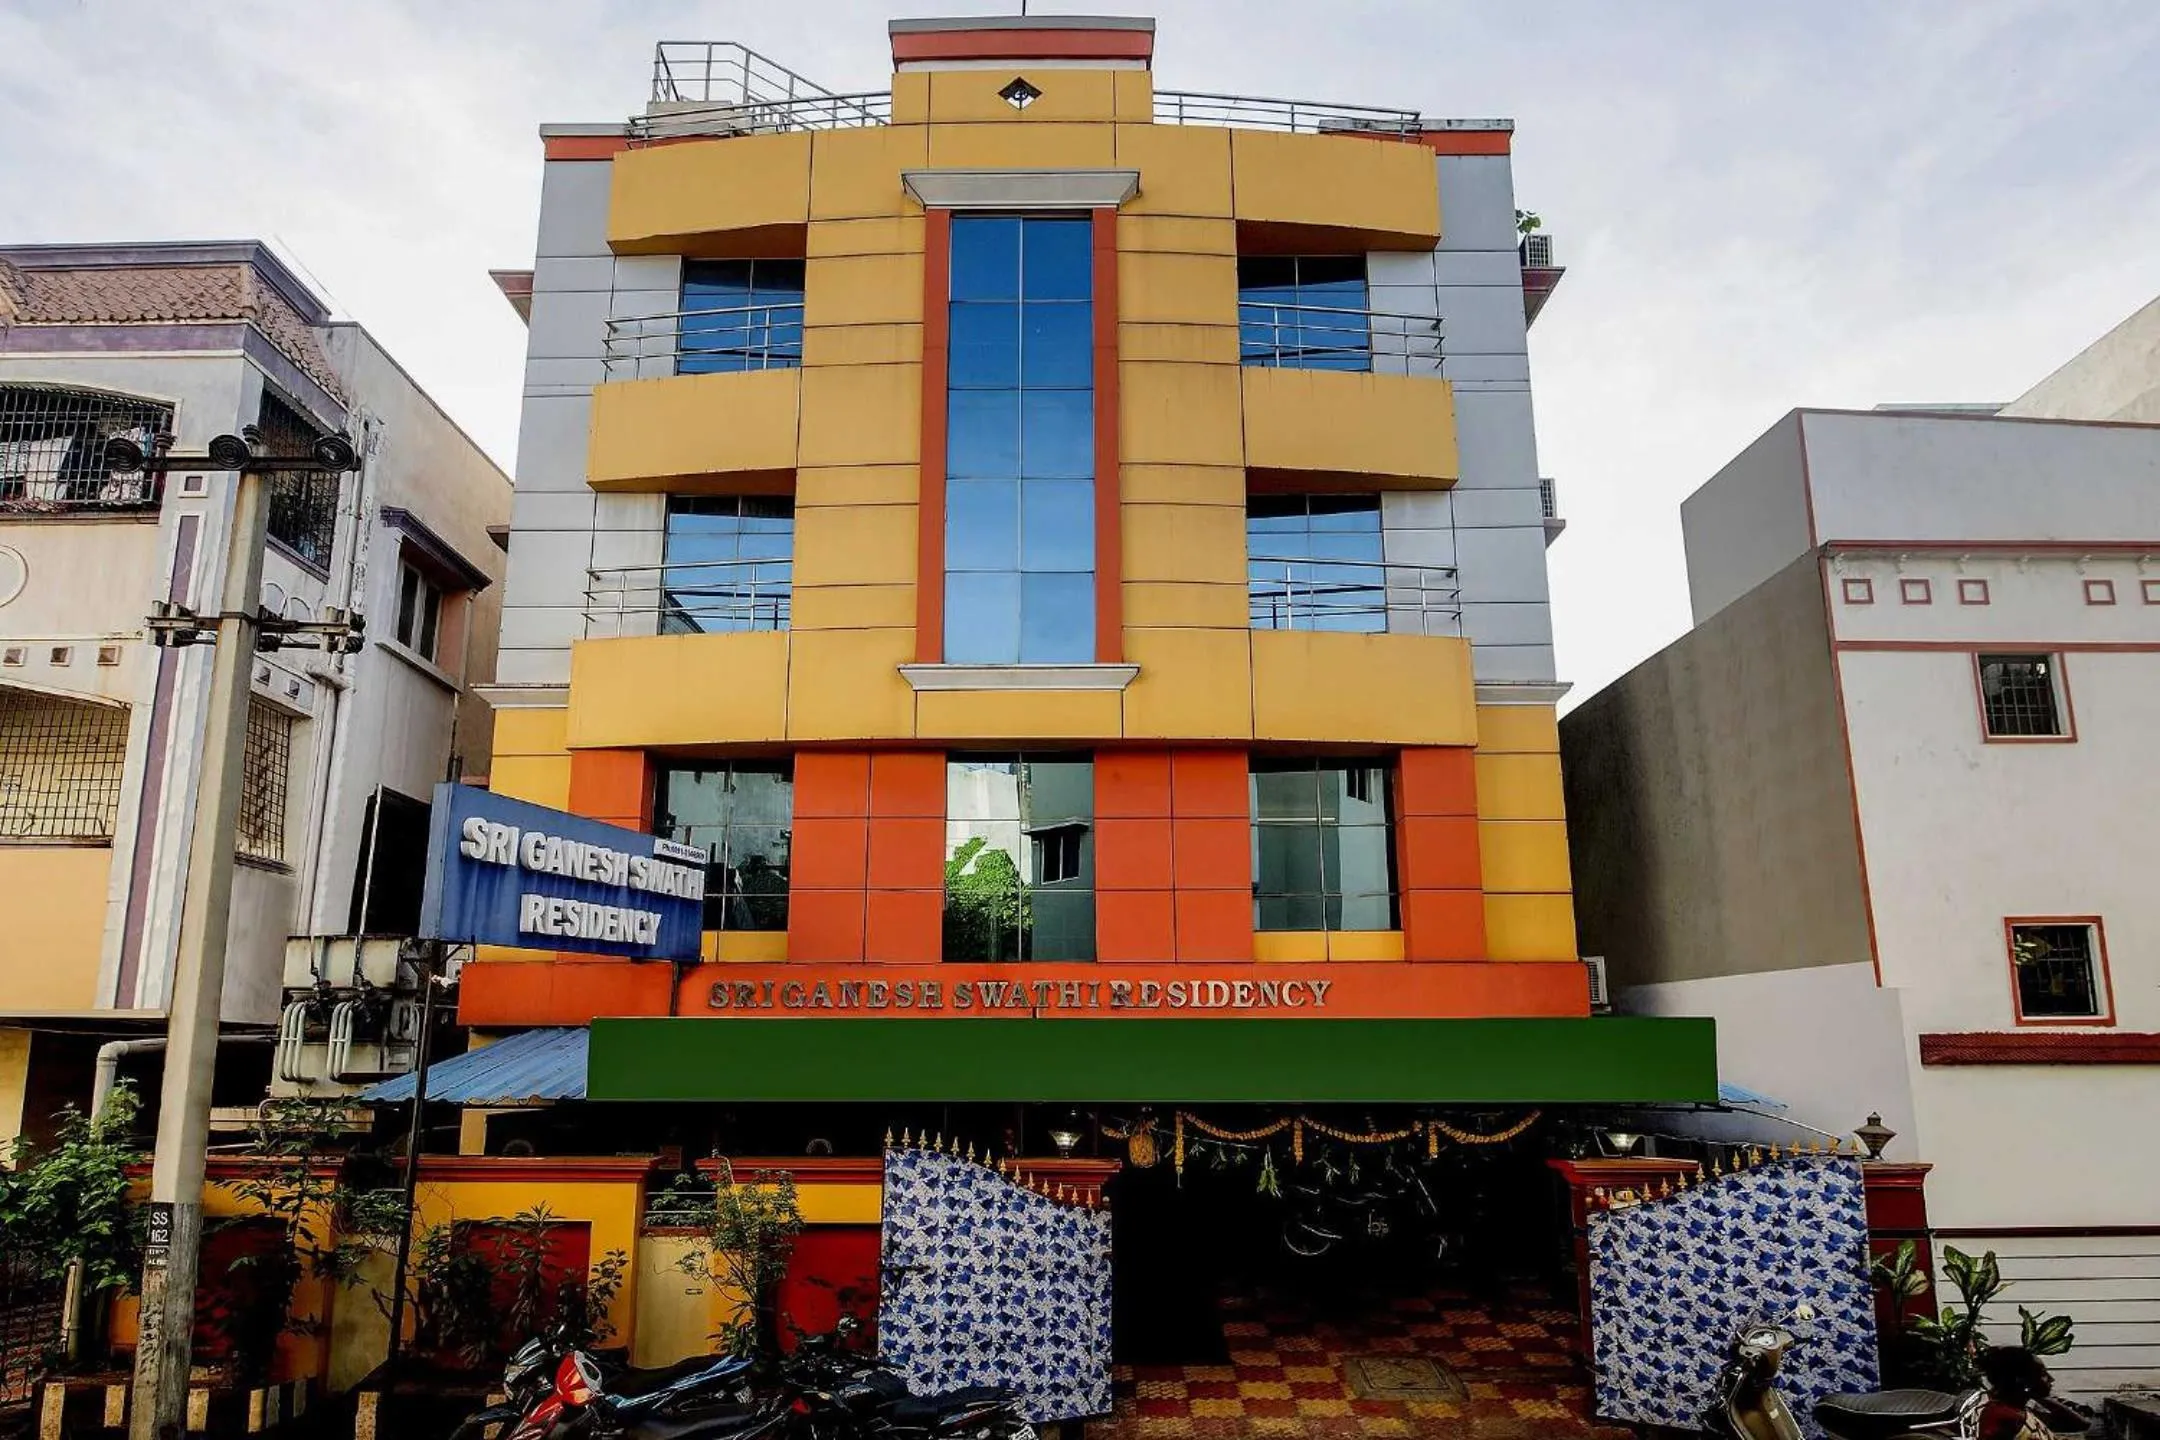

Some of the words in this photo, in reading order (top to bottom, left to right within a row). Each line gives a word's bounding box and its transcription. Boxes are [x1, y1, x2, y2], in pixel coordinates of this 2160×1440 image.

[460, 817, 519, 866] SRI
[520, 831, 629, 886] GANESH
[629, 855, 705, 900] SWATHI
[519, 893, 661, 945] RESIDENCY
[709, 980, 775, 1008] SRI
[782, 980, 943, 1008] GANESH
[953, 980, 1100, 1008] SWATHI
[1109, 979, 1333, 1008] RESIDENCY
[152, 1211, 168, 1225] SS
